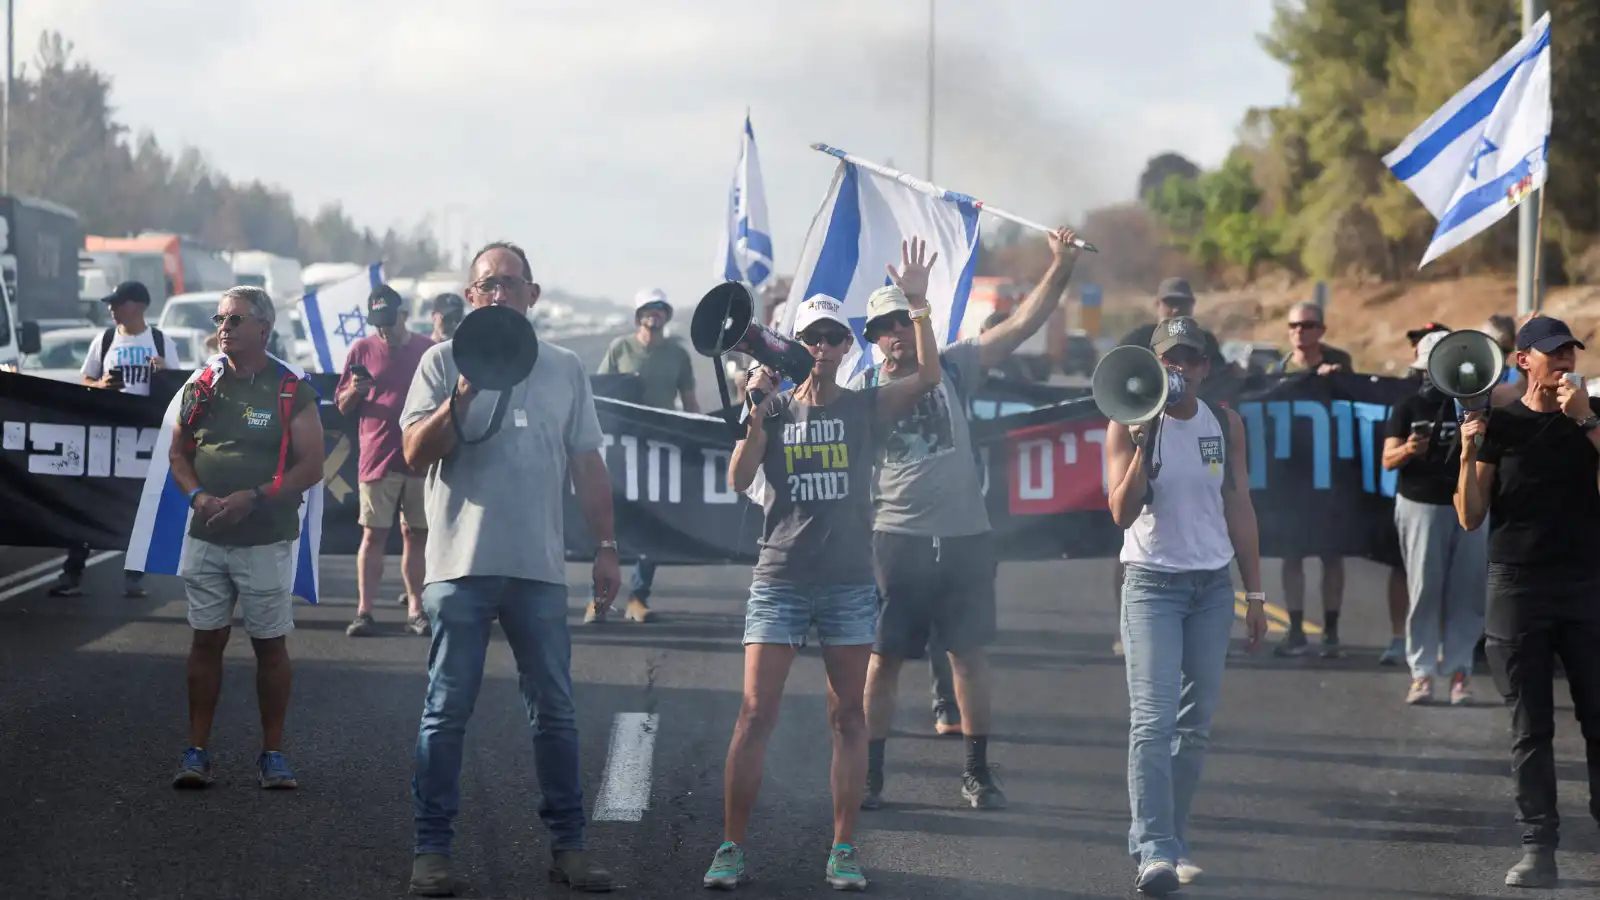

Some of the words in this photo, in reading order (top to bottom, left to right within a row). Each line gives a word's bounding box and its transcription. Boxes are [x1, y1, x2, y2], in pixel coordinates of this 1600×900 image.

[783, 421, 807, 444] הם
[810, 418, 845, 442] למה
[783, 443, 849, 473] עדיין
[787, 471, 849, 502] בעזה?
